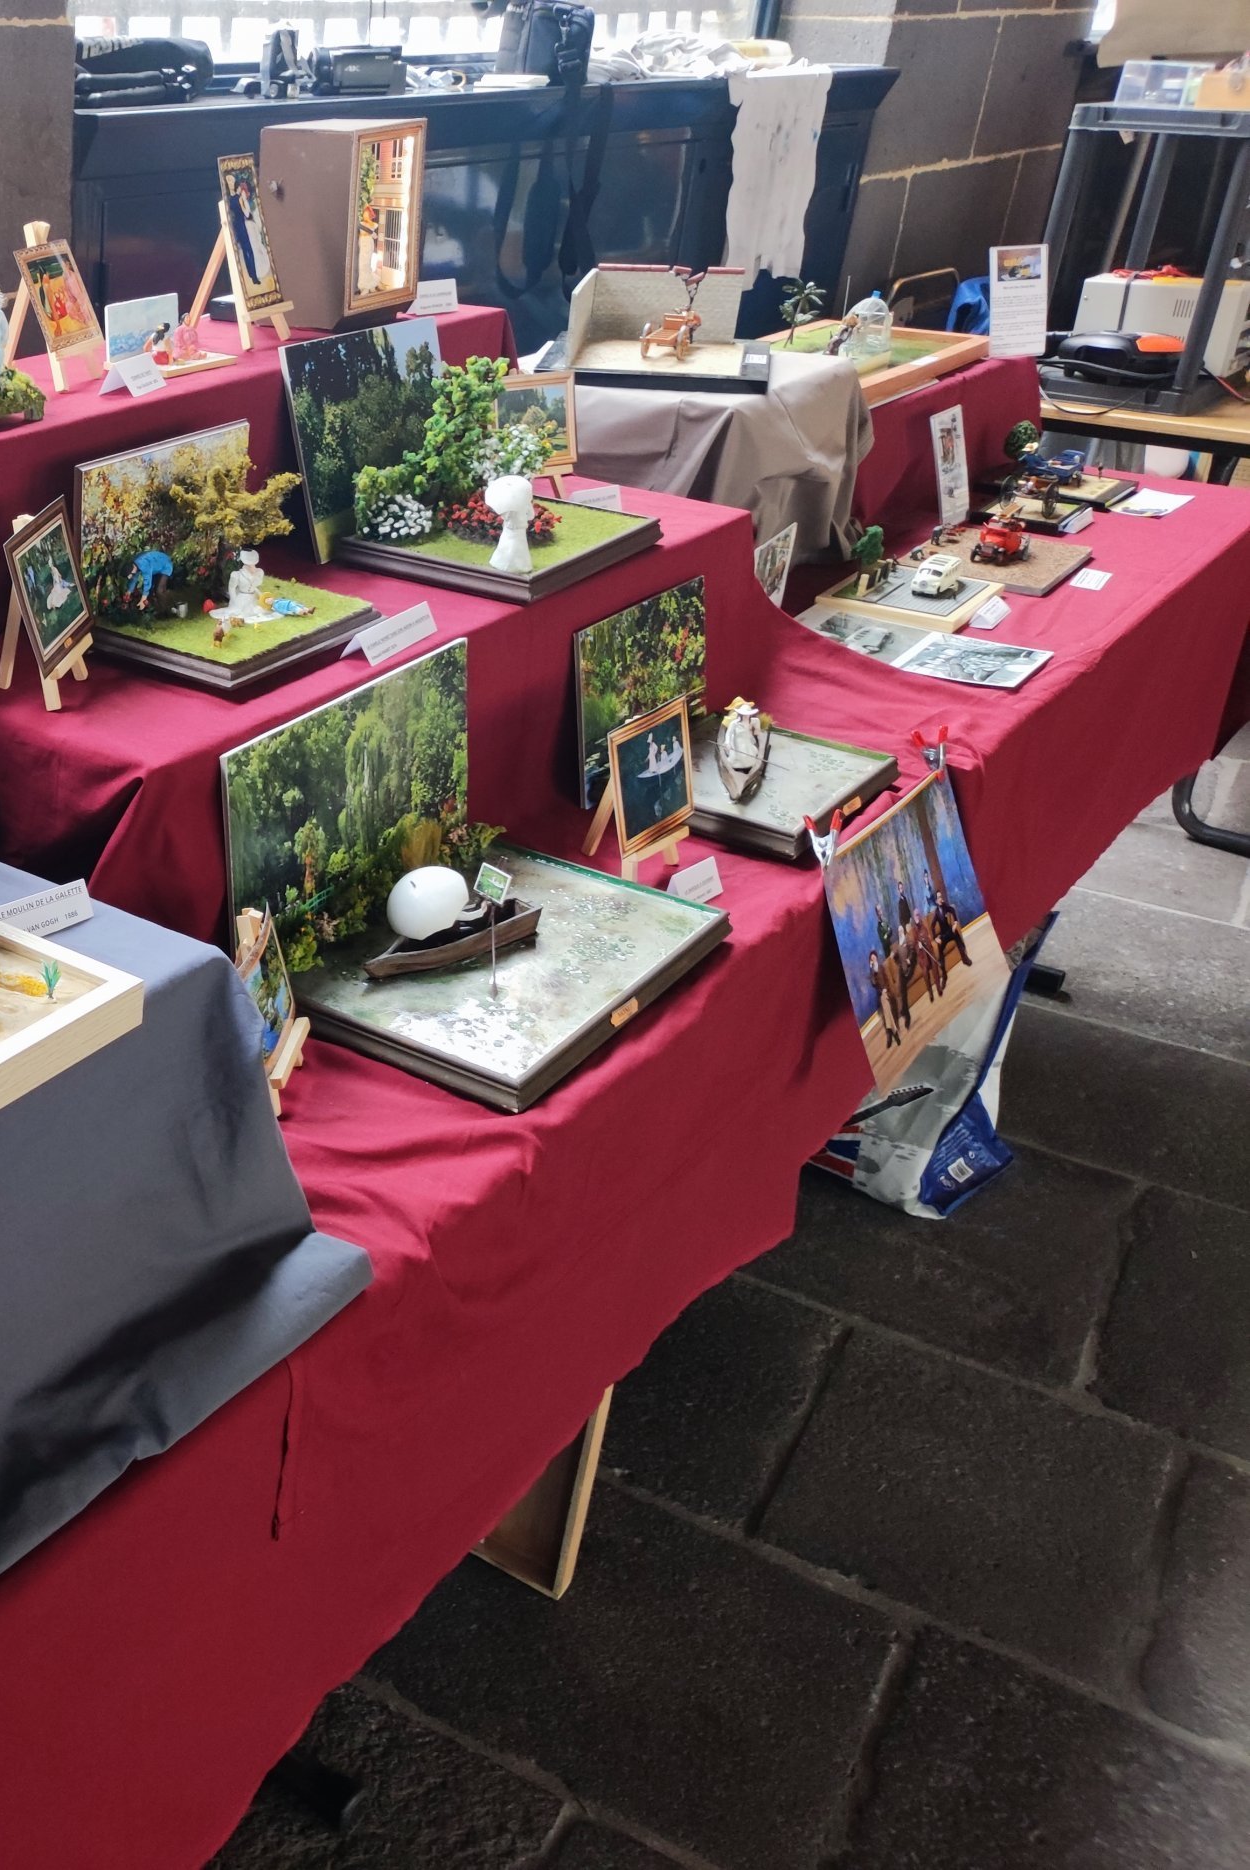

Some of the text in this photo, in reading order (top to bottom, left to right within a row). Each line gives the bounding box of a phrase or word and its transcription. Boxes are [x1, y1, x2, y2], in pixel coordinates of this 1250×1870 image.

[6, 902, 35, 916] MOULIN
[35, 898, 45, 907] DE
[45, 895, 56, 904] LA
[55, 886, 82, 899] GALETTE
[27, 924, 41, 933] VAN
[41, 917, 59, 928] GOGH
